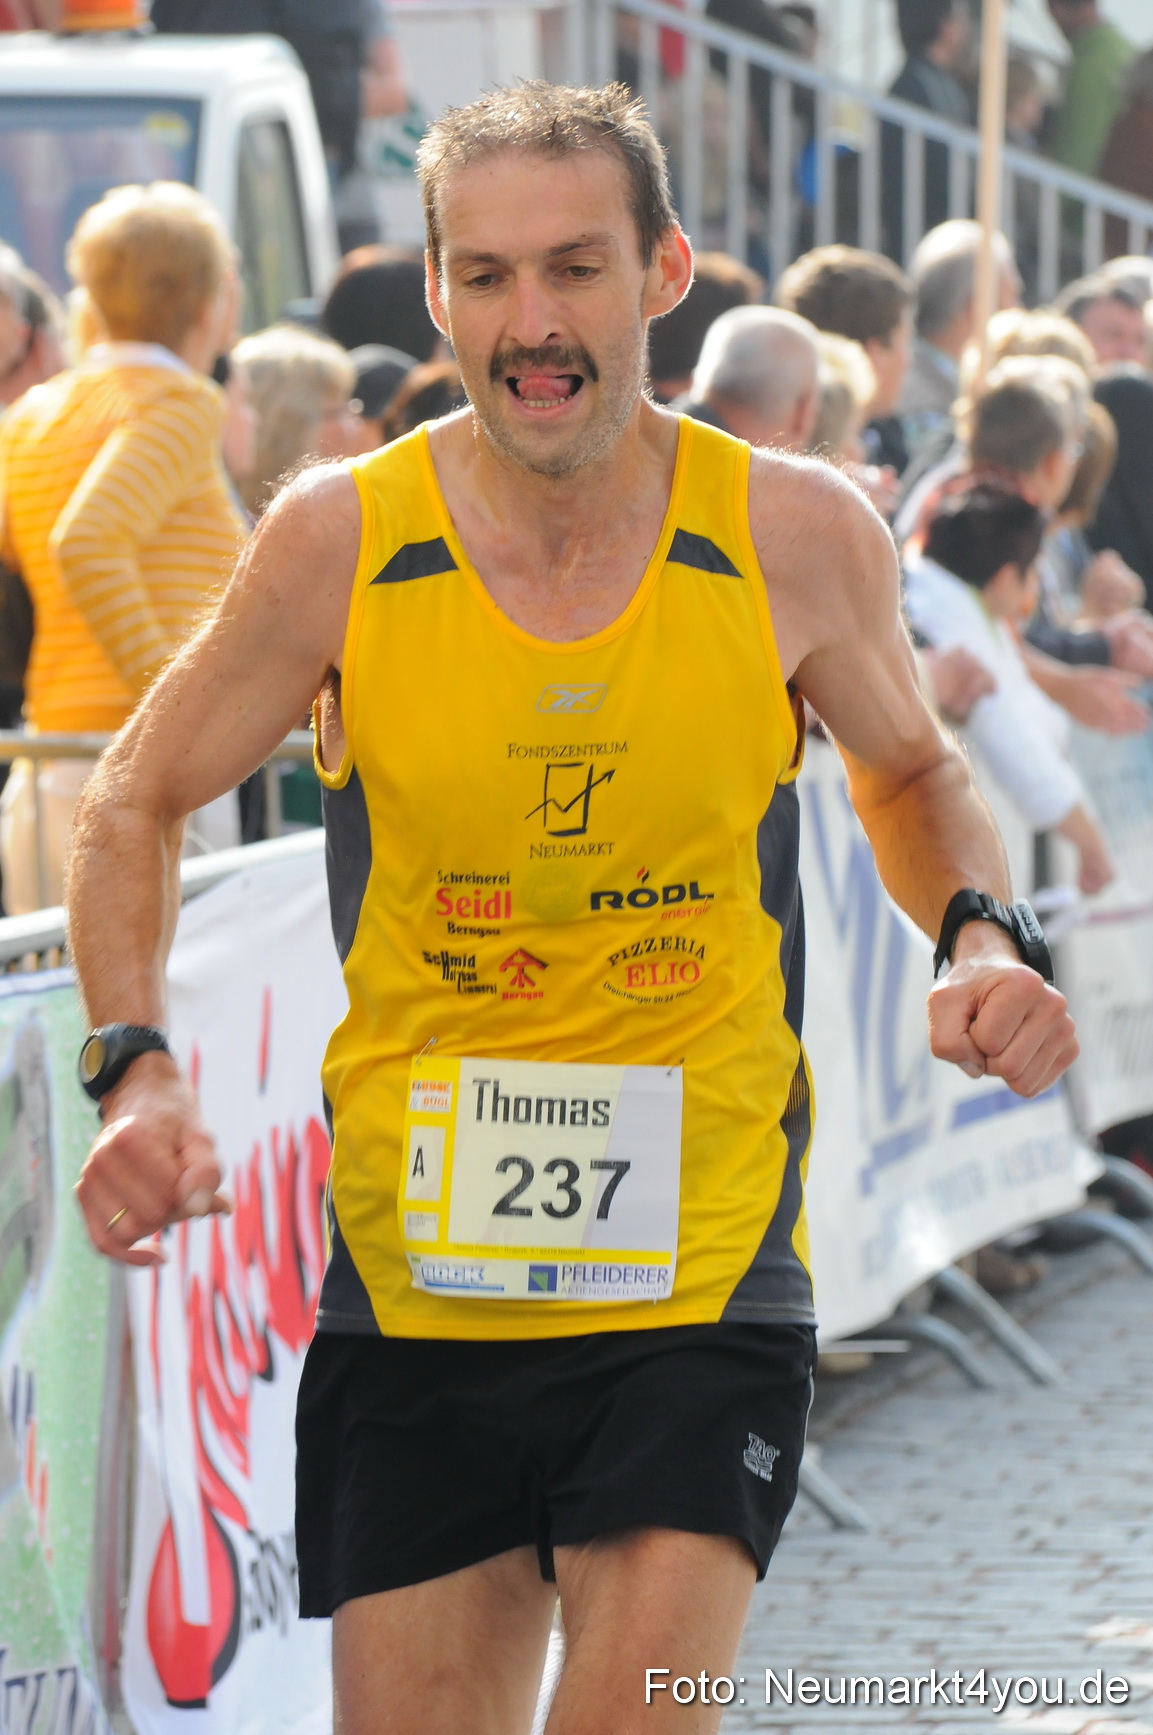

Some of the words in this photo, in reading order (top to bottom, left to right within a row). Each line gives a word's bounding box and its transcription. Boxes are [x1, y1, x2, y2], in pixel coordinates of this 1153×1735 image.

[529, 841, 616, 859] NEUMARKT
[438, 869, 511, 885] Schreinerei
[435, 887, 512, 919] Seidl
[607, 935, 706, 967] PIZZERIA
[625, 960, 701, 989] ELIO
[472, 1077, 611, 1127] Thomas
[411, 1146, 425, 1178] A
[491, 1155, 632, 1220] 237
[561, 1263, 669, 1285] PFLEIDERER
